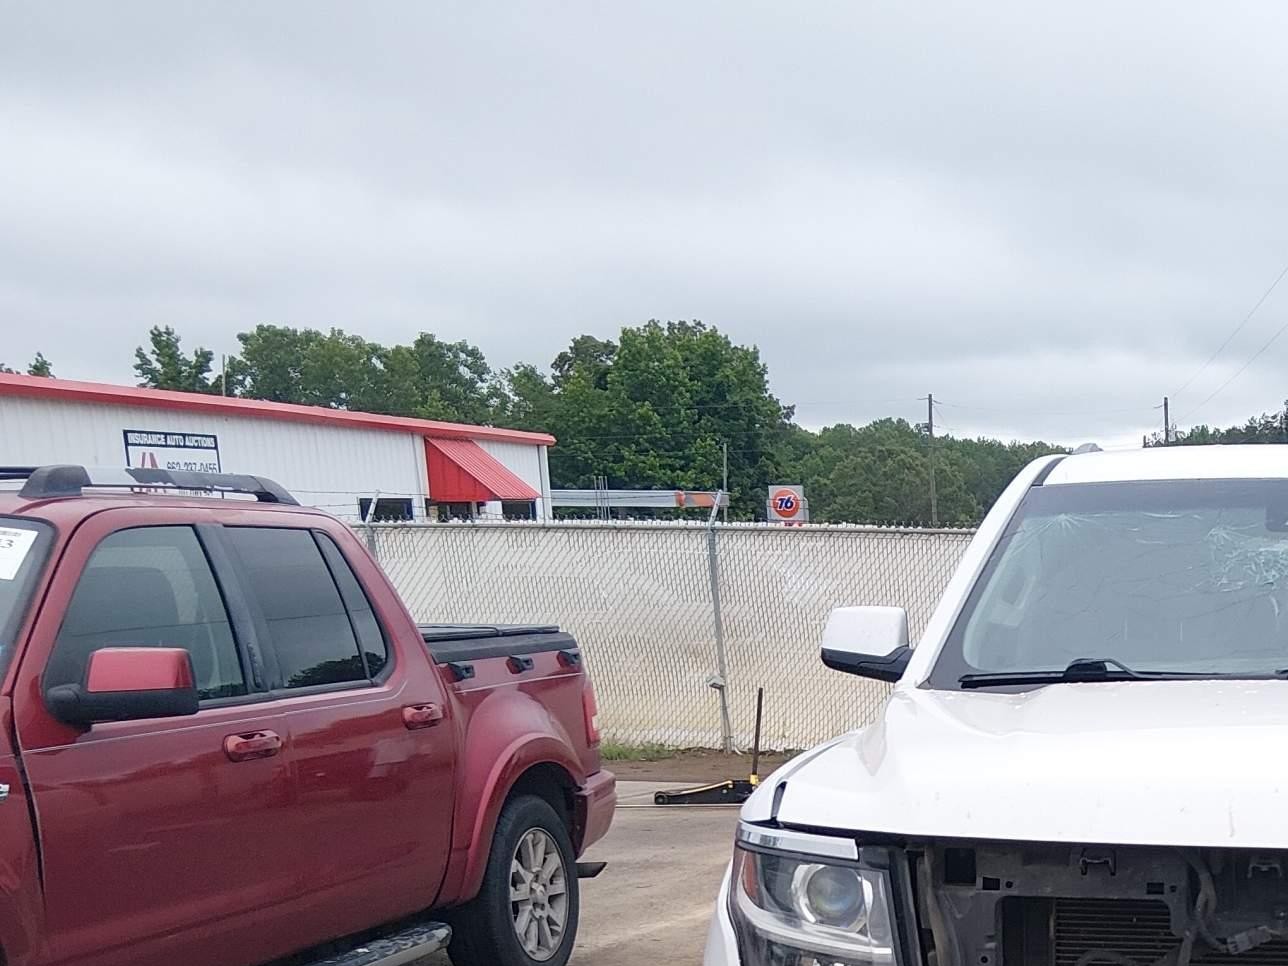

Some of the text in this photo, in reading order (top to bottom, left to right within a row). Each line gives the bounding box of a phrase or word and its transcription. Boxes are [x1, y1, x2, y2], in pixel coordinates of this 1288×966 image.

[127, 432, 215, 448] INSURANCE AUTO AUCTIONS
[777, 497, 794, 510] 76
